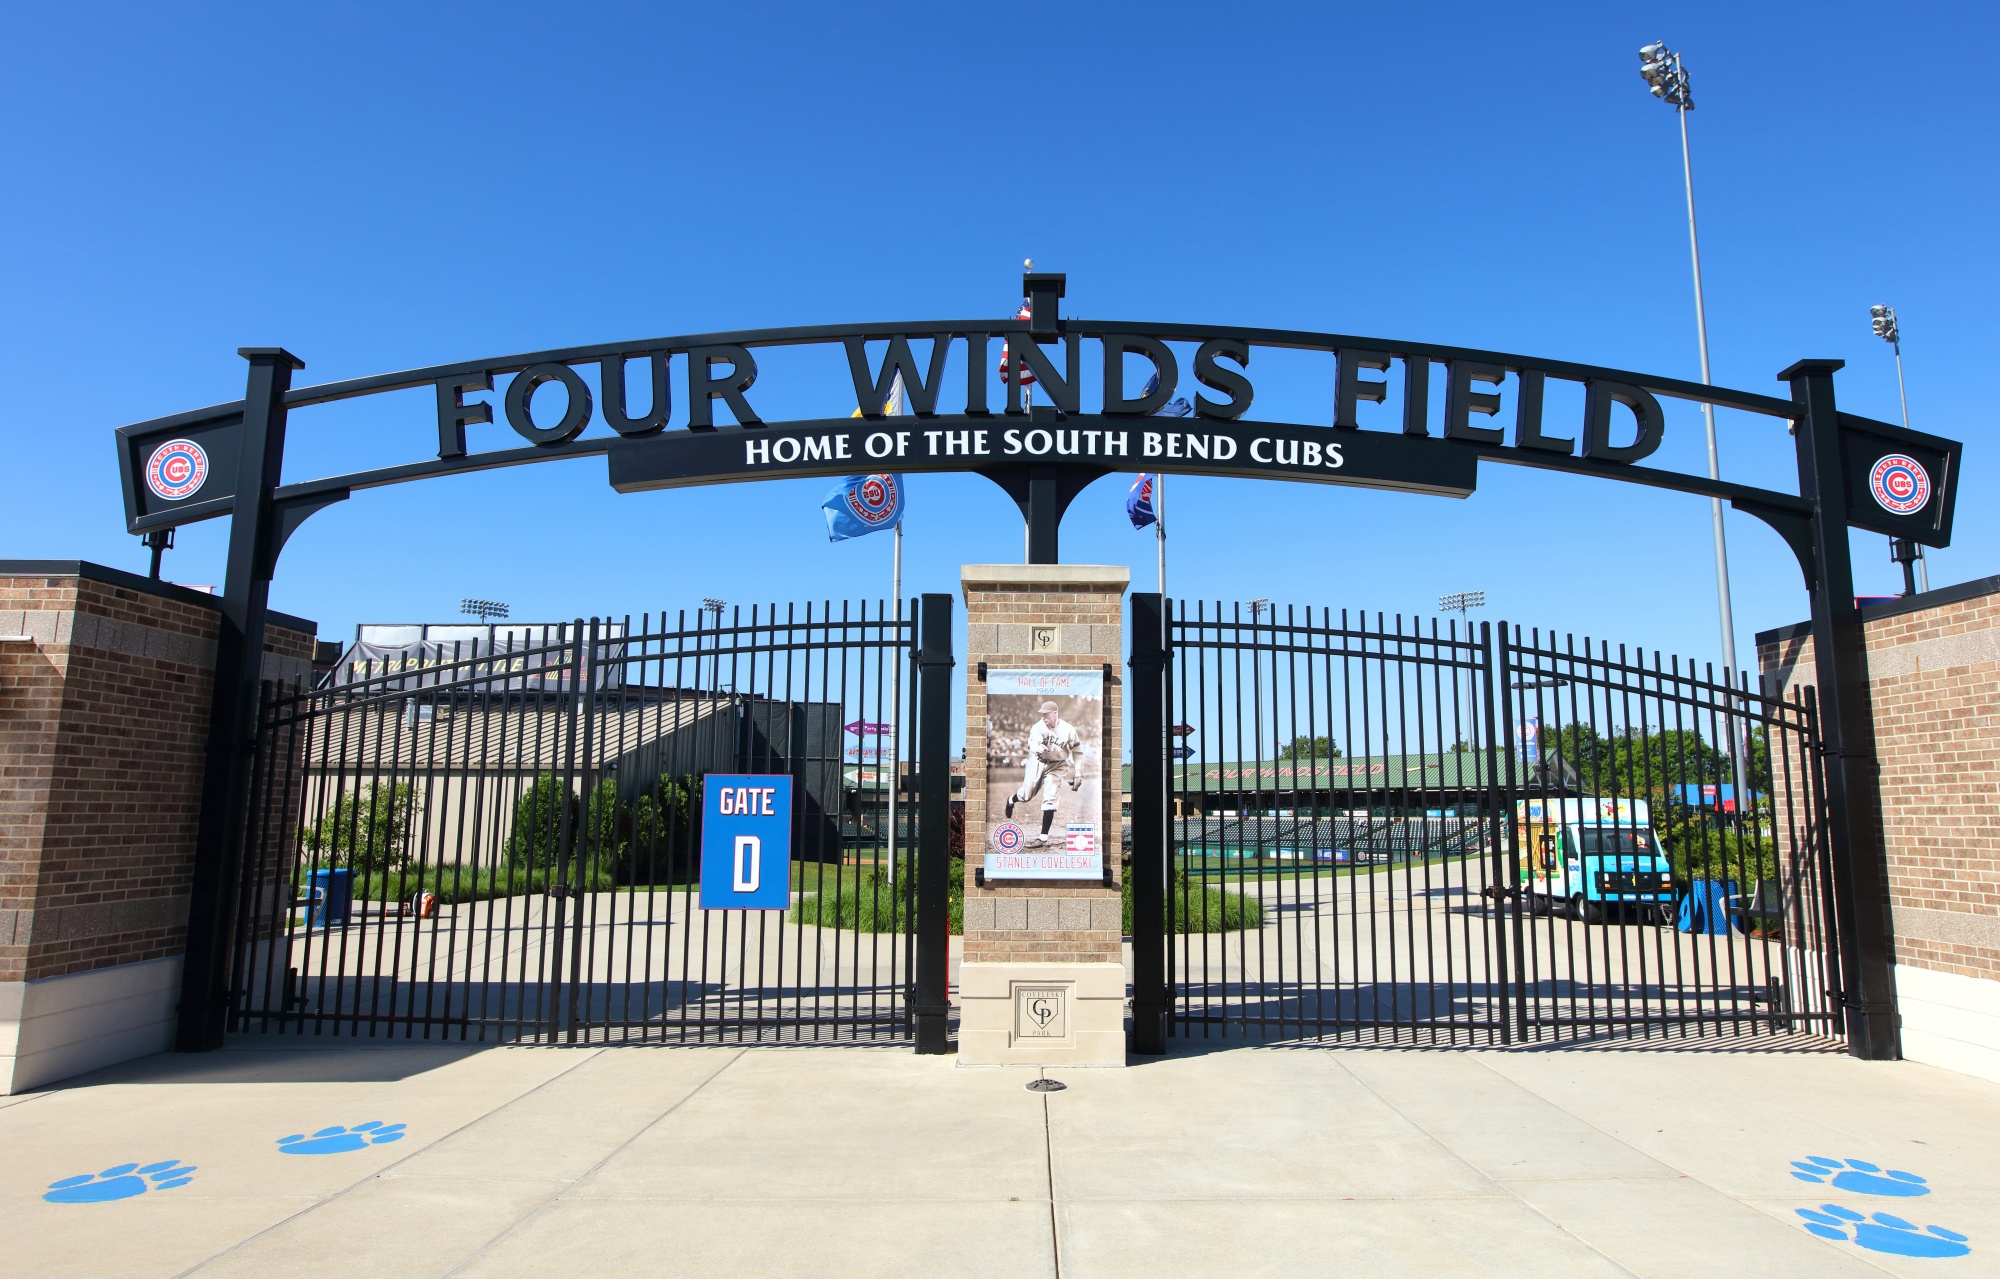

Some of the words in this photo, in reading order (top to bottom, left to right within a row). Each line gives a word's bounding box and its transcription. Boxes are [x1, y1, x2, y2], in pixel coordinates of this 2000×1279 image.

[435, 344, 764, 459] FOUR
[842, 331, 1254, 420] WINDS
[1332, 346, 1665, 465] FIELD
[153, 445, 180, 467] SOUTH
[183, 445, 203, 464] BEND
[745, 433, 852, 465] HOME
[865, 431, 911, 458] OF
[923, 430, 991, 456] THE
[1003, 429, 1129, 456] SOUTH
[1143, 431, 1238, 460] BEND
[1250, 437, 1344, 469] CUBS
[1875, 459, 1898, 479] SOUTH
[1901, 460, 1923, 480] BEND
[1037, 630, 1050, 647] CP
[1018, 677, 1038, 688] HALL
[1039, 677, 1050, 688] OF
[1051, 677, 1071, 688] FAME
[1035, 687, 1055, 695] 1969
[719, 787, 776, 816] GATE
[733, 835, 762, 893] D
[996, 856, 1038, 869] STANLEY
[1041, 856, 1092, 869] COVELESKI
[1032, 999, 1052, 1025] CP
